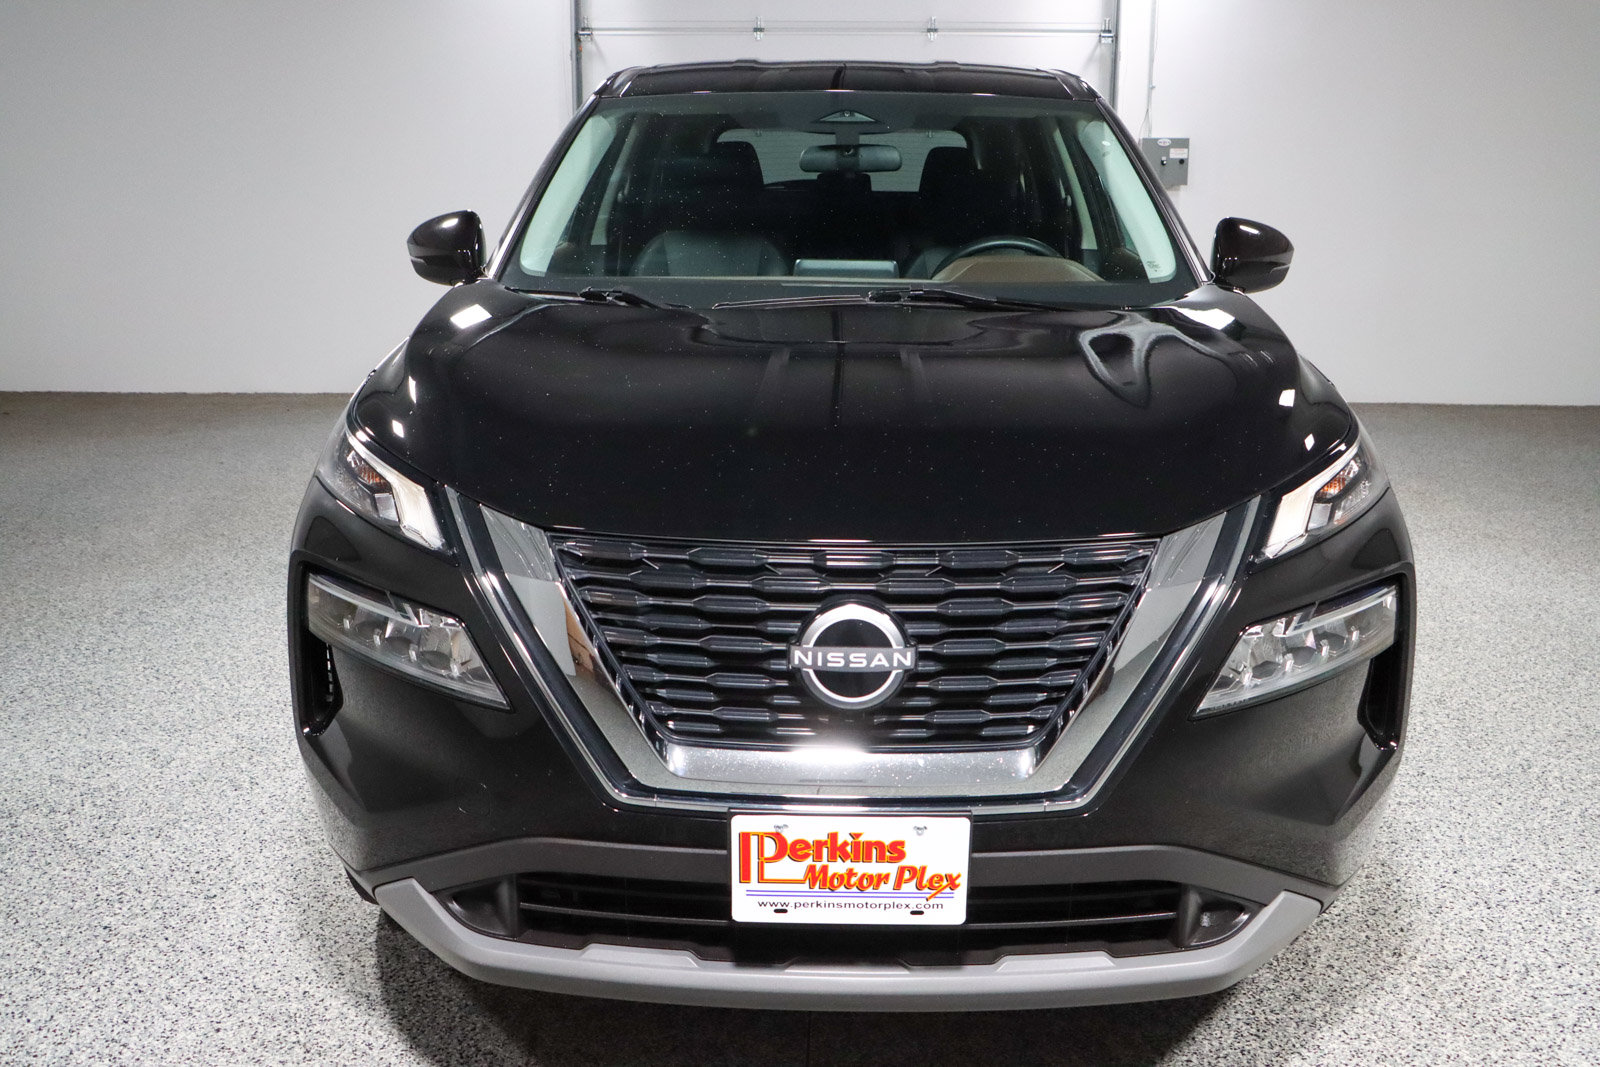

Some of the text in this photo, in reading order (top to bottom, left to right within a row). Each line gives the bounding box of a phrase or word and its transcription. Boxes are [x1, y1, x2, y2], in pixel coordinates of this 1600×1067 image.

[794, 650, 912, 668] NISSAN
[739, 831, 907, 883] Perkins
[803, 864, 962, 901] Motor Plex
[757, 899, 944, 910] www.perkinsmotorplex.com
